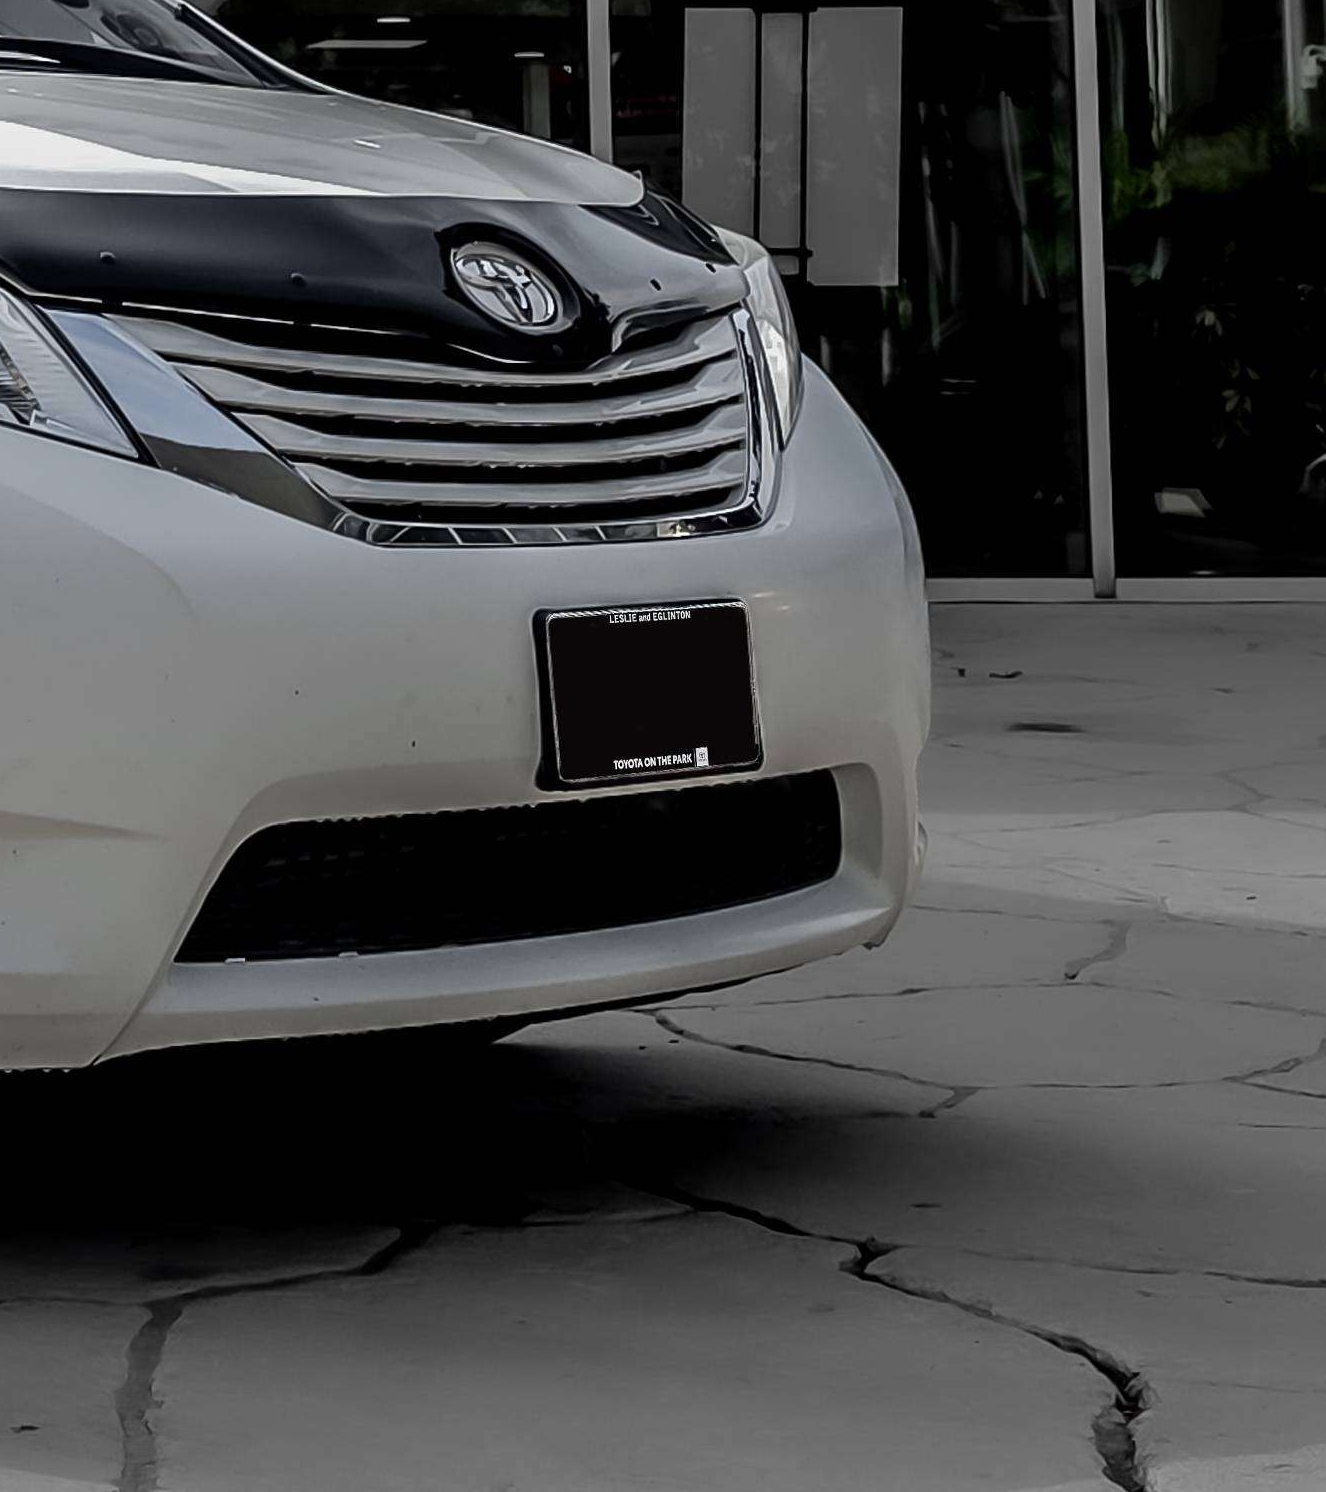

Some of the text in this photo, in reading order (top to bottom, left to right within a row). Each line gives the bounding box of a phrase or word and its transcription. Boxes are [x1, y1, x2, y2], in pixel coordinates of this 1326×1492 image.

[609, 610, 691, 624] LESLIE and EGLINTON
[613, 752, 692, 770] TOYOTA ON THE PARK
